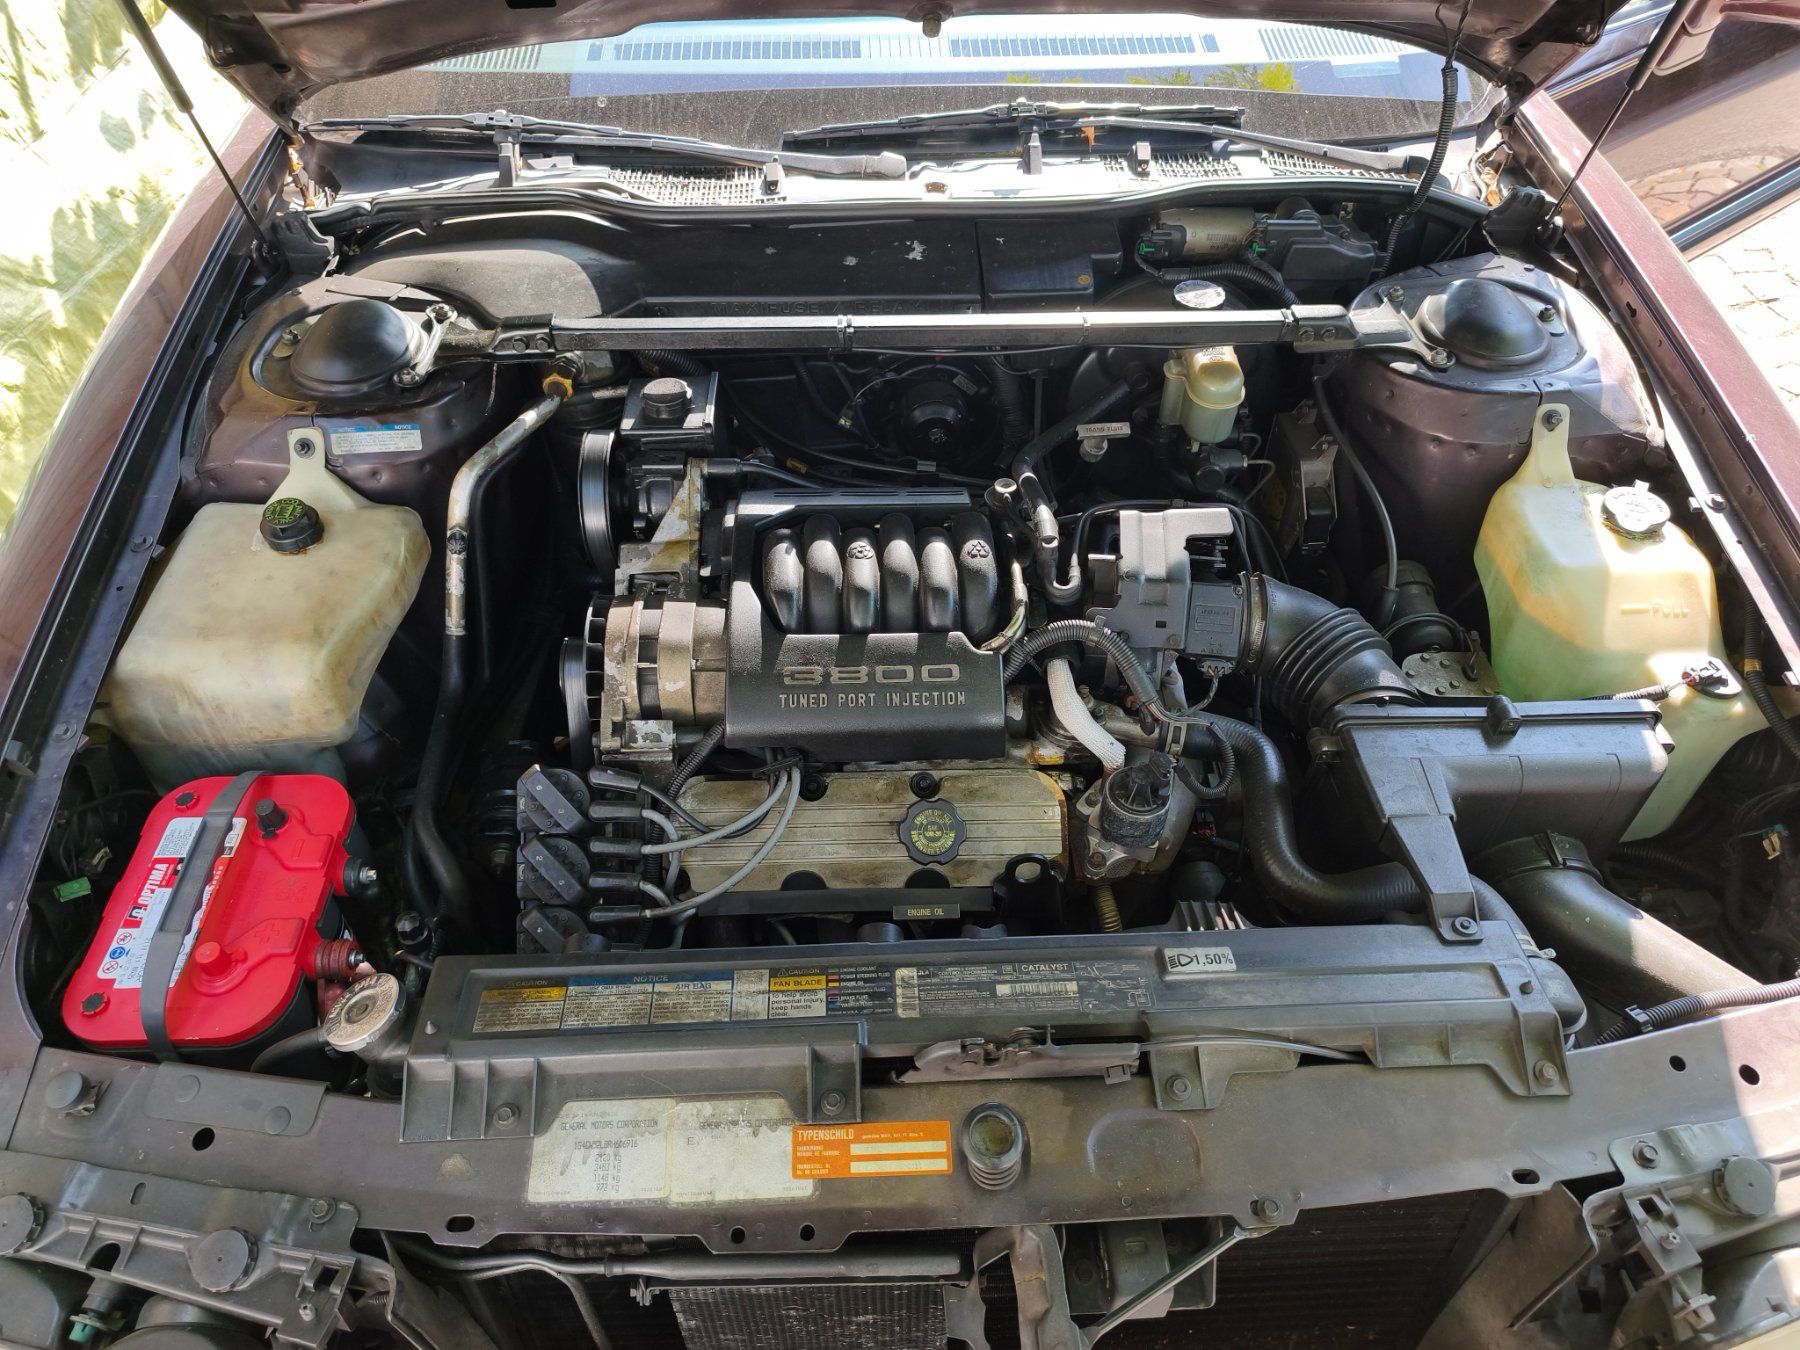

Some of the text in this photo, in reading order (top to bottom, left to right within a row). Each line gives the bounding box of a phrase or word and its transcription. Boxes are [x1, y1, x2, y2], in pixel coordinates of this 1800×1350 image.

[782, 664, 960, 685] 3800
[779, 691, 966, 708] TUNED PORT INJECTION
[137, 864, 170, 904] OPTIMA
[907, 908, 944, 916] ENGINE OIL
[1022, 964, 1069, 972] CATALYST
[633, 974, 670, 982] NOTICE
[793, 978, 823, 986] BLADE
[675, 982, 712, 990] AIR BAG
[560, 1119, 659, 1131] GENERAL MOTORS CORPORATION
[796, 1128, 854, 1141] TYPENSCHILD
